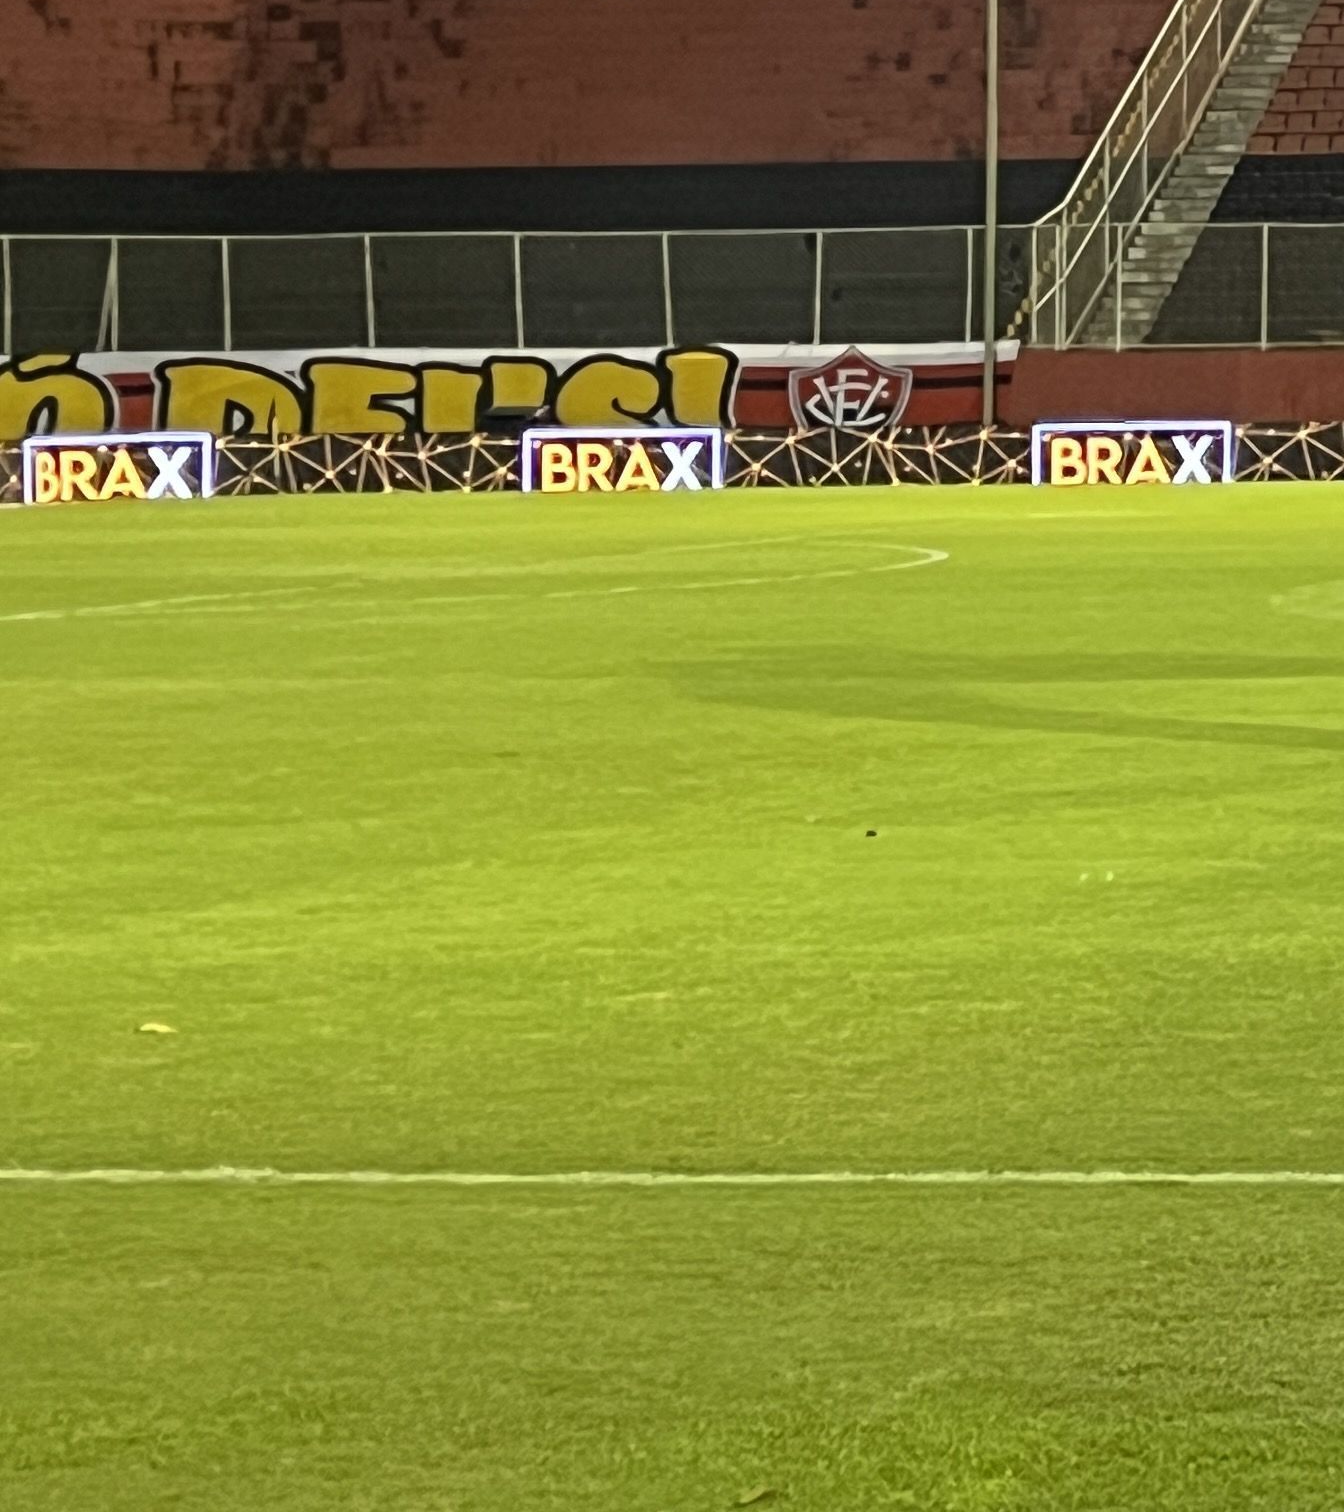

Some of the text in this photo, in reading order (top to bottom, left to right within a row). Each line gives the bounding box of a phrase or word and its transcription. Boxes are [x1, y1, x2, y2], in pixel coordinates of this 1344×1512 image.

[35, 445, 194, 503] BRAX
[541, 439, 704, 492] BRAX
[1051, 433, 1214, 486] BRAX
